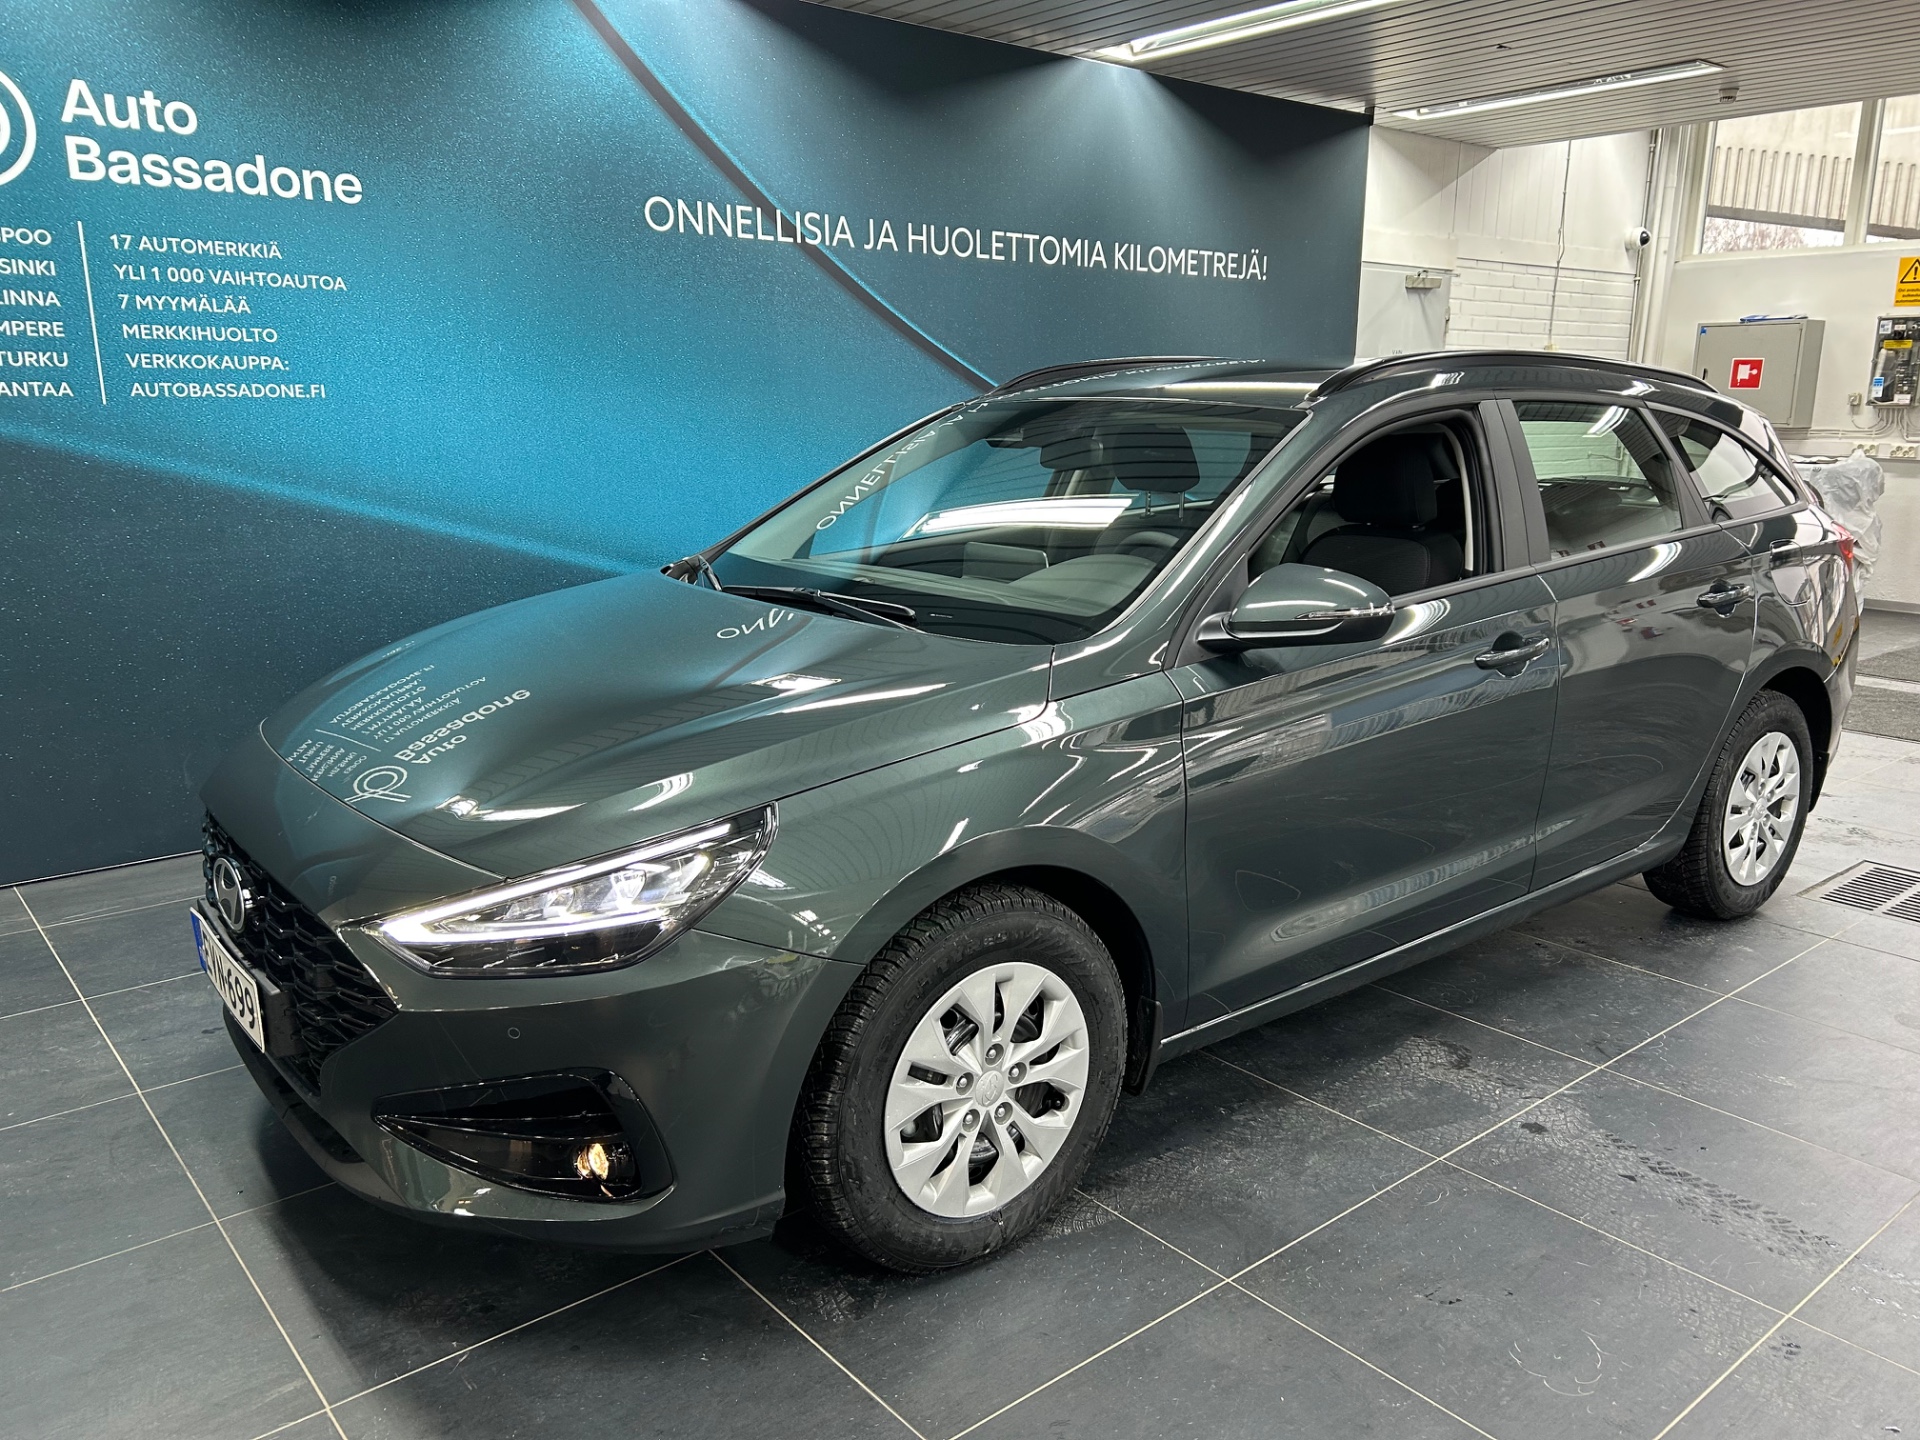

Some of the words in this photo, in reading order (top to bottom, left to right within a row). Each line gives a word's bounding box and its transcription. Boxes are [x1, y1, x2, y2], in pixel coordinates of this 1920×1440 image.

[61, 79, 198, 135] Auto
[65, 135, 363, 205] Bassadone
[0, 227, 52, 245] POO
[109, 234, 132, 250] 17
[138, 235, 282, 259] AUTOMERKKIÄ
[644, 196, 855, 248] ONNELLISIA
[864, 219, 899, 252] JA
[907, 222, 1107, 269] HUOLETTOMIA
[1114, 243, 1268, 281] KILOMETREJÄ!
[113, 263, 146, 281] YLI
[151, 266, 160, 281] 1
[167, 267, 204, 284] 000
[208, 269, 348, 291] VAIHTOAUTOA
[118, 294, 129, 310] 7
[135, 294, 251, 314] MYYMÄLÄÄ
[121, 324, 278, 343] MERKKIHUOLTO
[125, 353, 290, 371] VERKKOKAUPPA:
[130, 382, 327, 398] AUTOBASSADONE.FI
